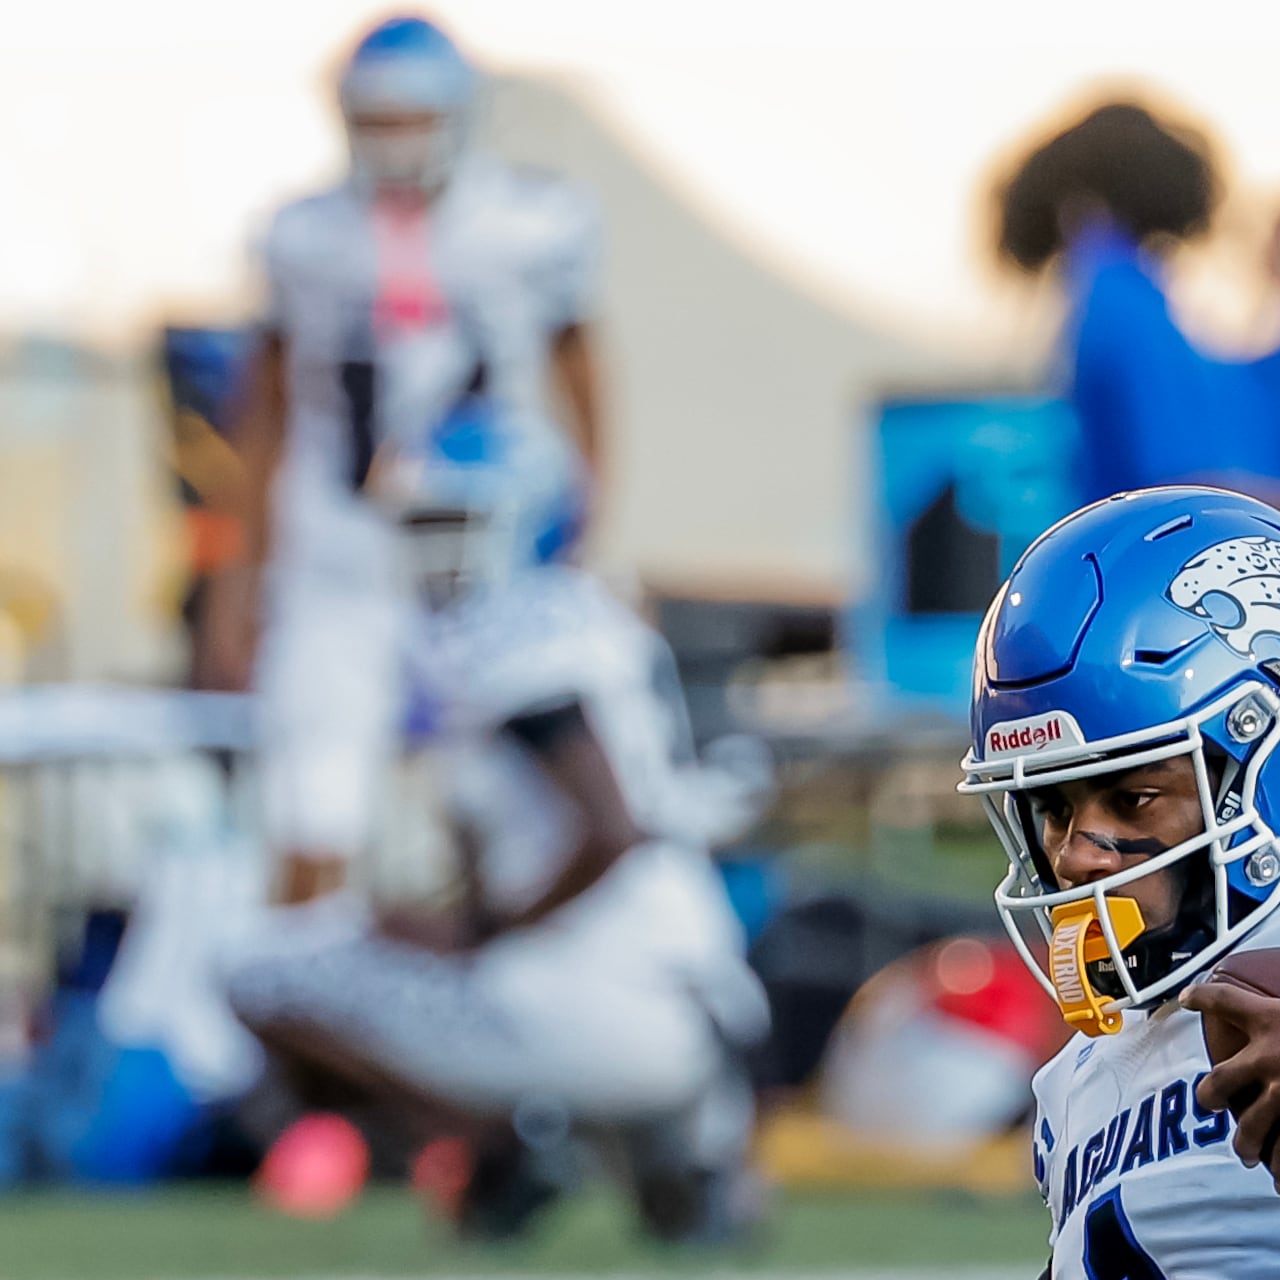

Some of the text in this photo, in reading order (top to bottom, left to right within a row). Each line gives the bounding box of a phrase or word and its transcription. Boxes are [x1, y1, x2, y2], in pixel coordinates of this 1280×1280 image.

[990, 718, 1062, 753] Riddell
[1053, 924, 1086, 1004] NXTRND
[1057, 1071, 1231, 1236] AGUARS
